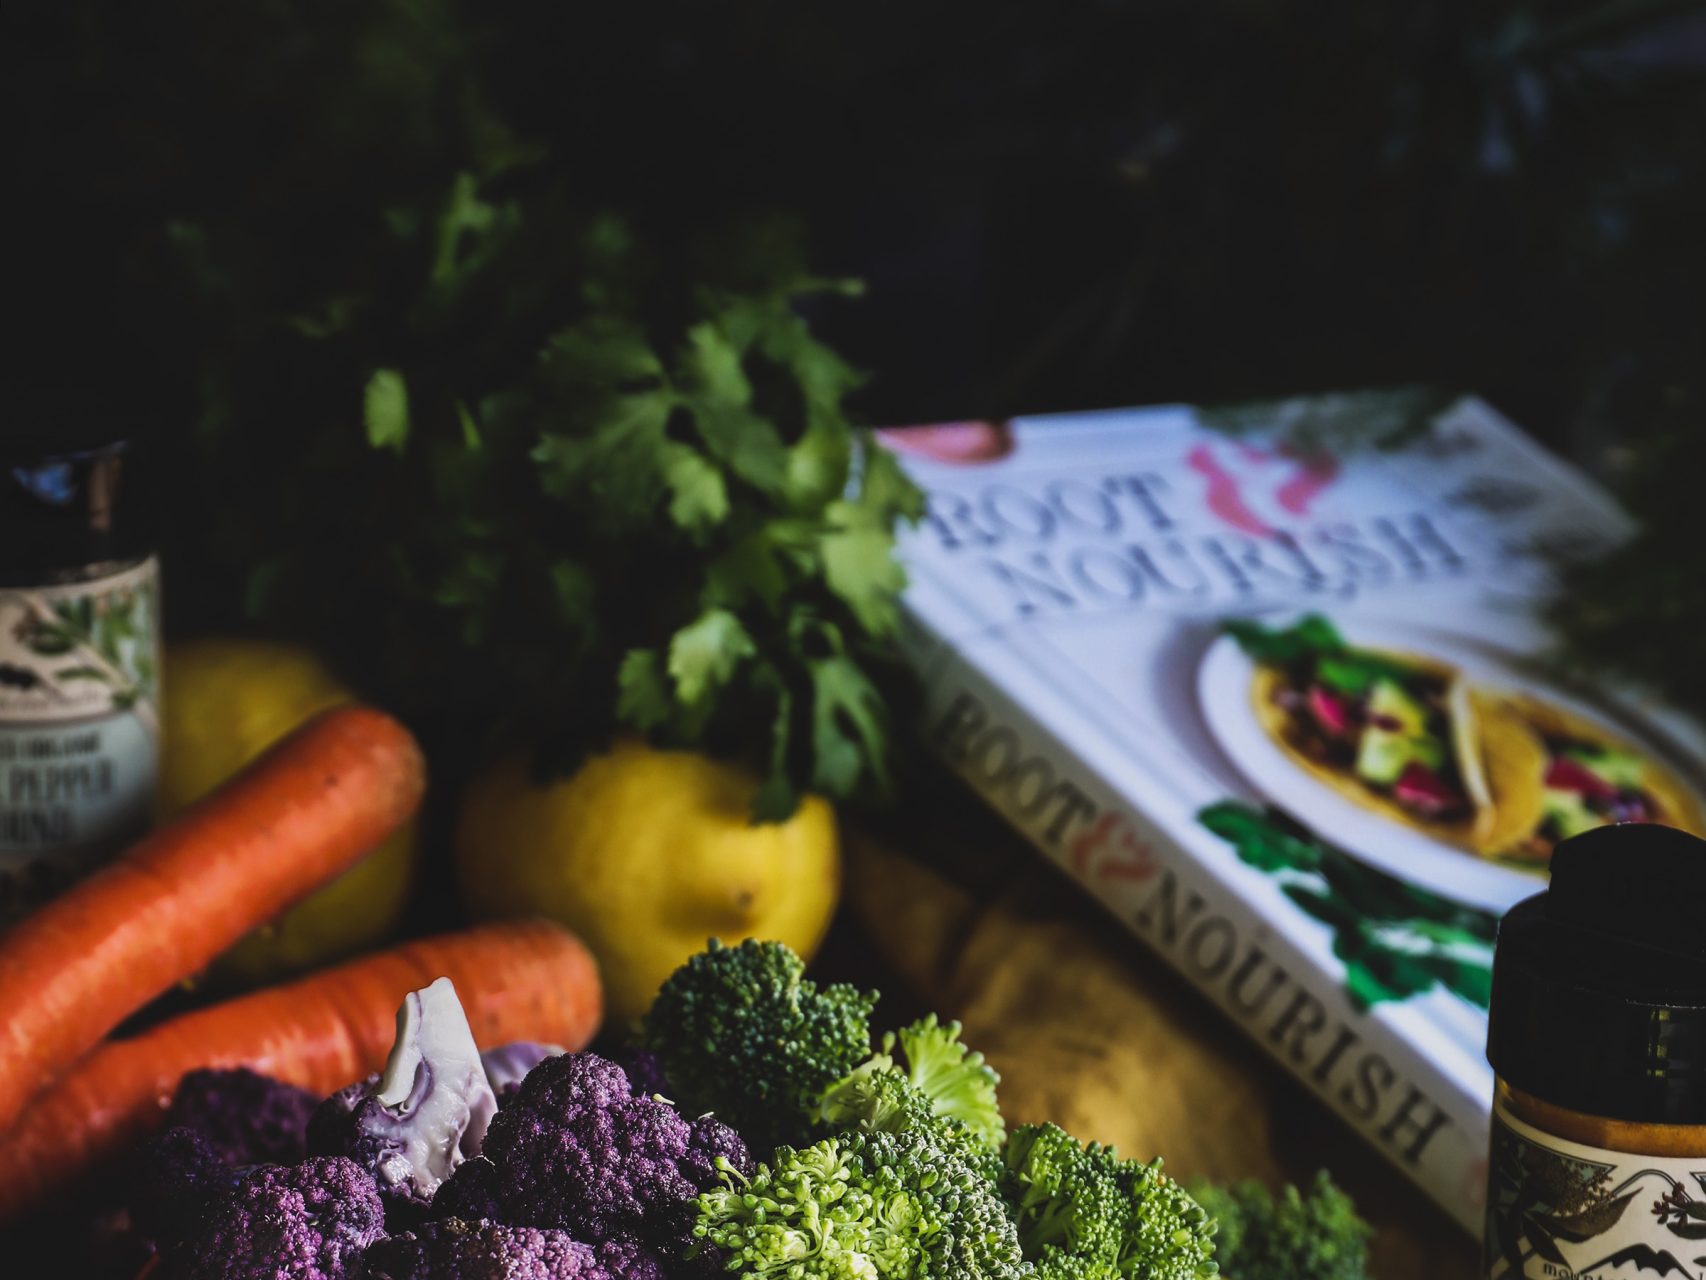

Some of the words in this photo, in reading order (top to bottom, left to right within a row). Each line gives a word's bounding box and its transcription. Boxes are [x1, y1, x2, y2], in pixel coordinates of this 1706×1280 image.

[926, 472, 1172, 549] ROOT
[1000, 510, 1462, 615] NOURISH
[935, 693, 1096, 847] ROOT
[1137, 868, 1455, 1166] NOURISH
